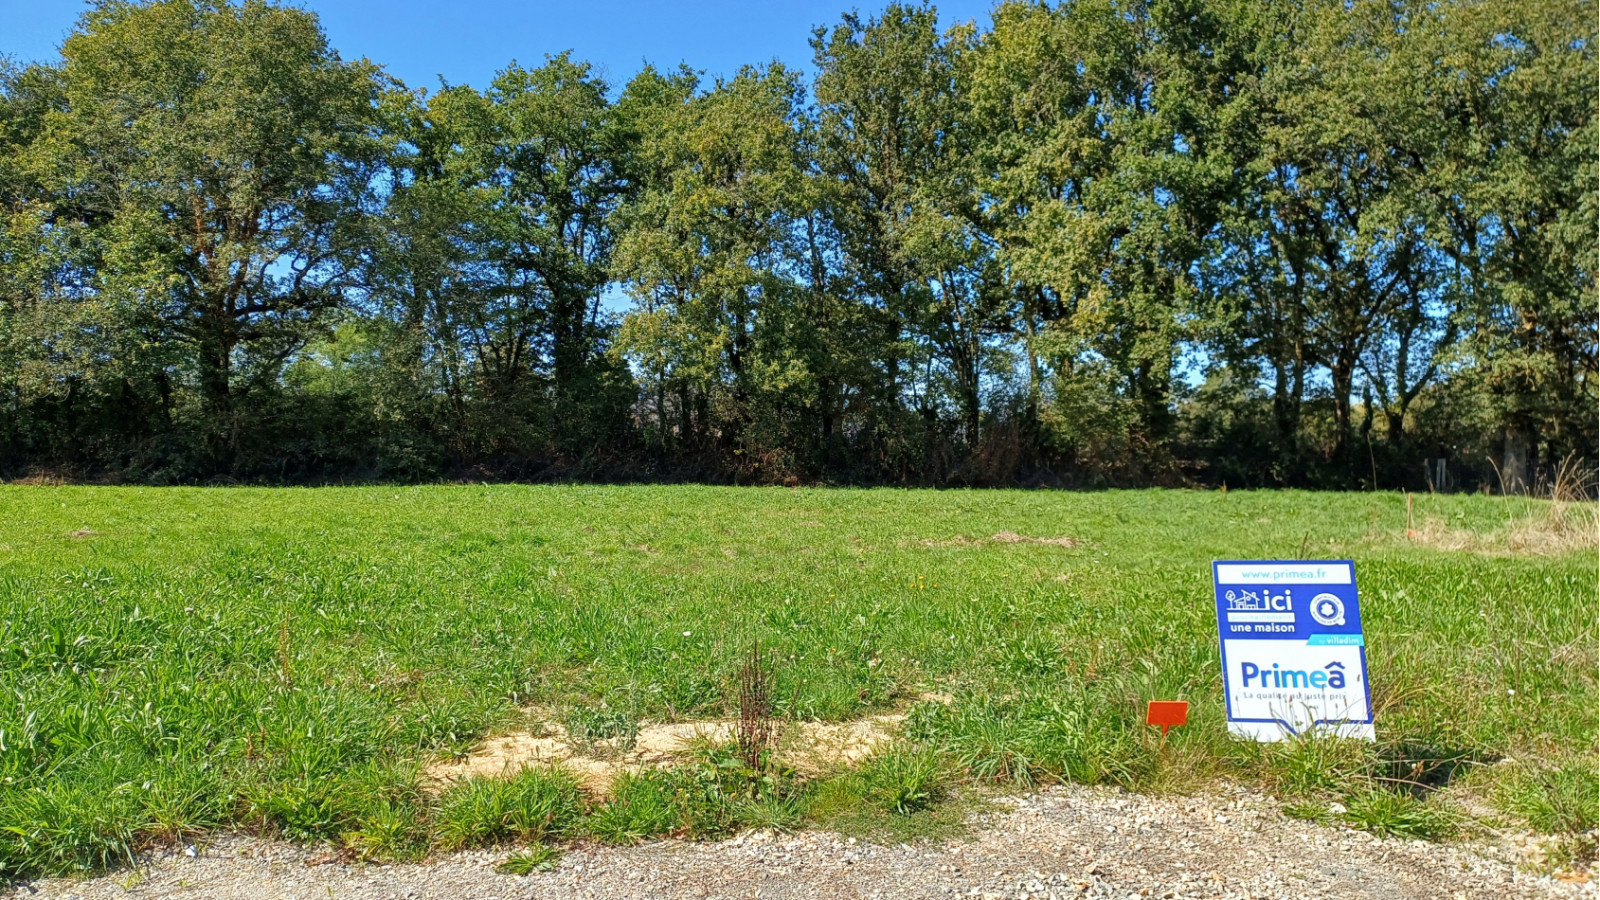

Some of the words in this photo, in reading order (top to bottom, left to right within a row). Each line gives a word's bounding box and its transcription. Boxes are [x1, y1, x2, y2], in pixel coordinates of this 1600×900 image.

[1242, 568, 1326, 581] www.primea.fr
[1263, 589, 1293, 611] ici
[1230, 624, 1252, 633] une
[1254, 622, 1295, 633] maison
[1327, 635, 1360, 645] villadim
[1241, 661, 1346, 689] Primeâ
[1256, 692, 1288, 701] qualié
